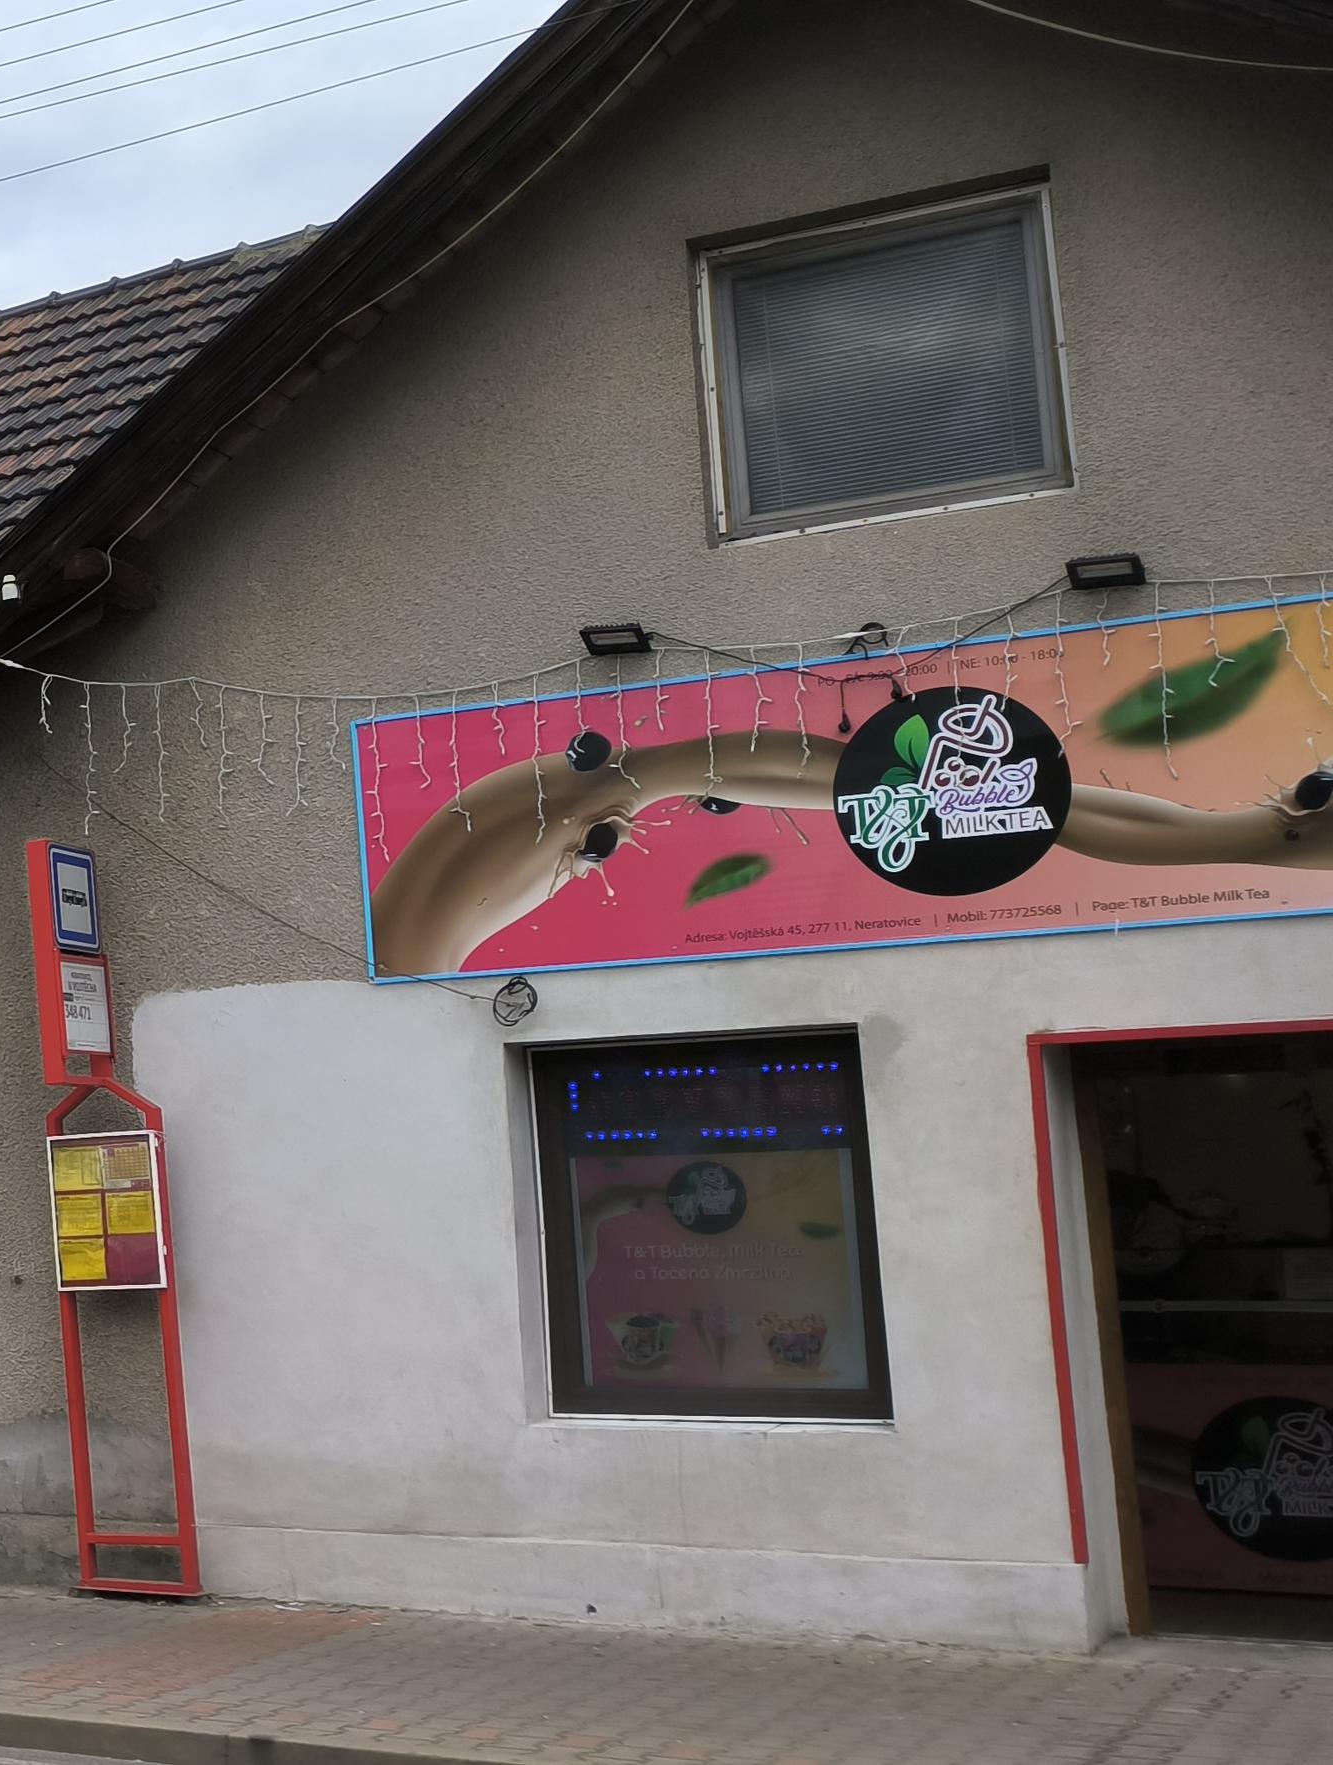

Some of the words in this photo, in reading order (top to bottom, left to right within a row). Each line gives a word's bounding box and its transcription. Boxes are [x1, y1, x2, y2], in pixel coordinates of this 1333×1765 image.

[905, 663, 938, 677] 20:00
[960, 658, 981, 671] NE:
[938, 774, 1033, 815] Bubble
[944, 813, 1000, 836] MILK
[1006, 808, 1049, 830] TEA
[1091, 899, 1129, 914] Page:
[1130, 896, 1158, 910] T&T
[1160, 892, 1211, 908] Bubble
[1213, 888, 1244, 903] Milk
[1245, 887, 1271, 901] Tea
[946, 910, 987, 924] Mobil:
[989, 903, 1062, 920] 773725568
[684, 932, 728, 945] Adresa:
[729, 926, 785, 942] Vojtěšská
[786, 923, 806, 938] 45,
[808, 922, 831, 935] 277
[834, 920, 853, 934] 11,
[853, 915, 922, 931] Neratovice
[622, 1244, 658, 1259] T&T
